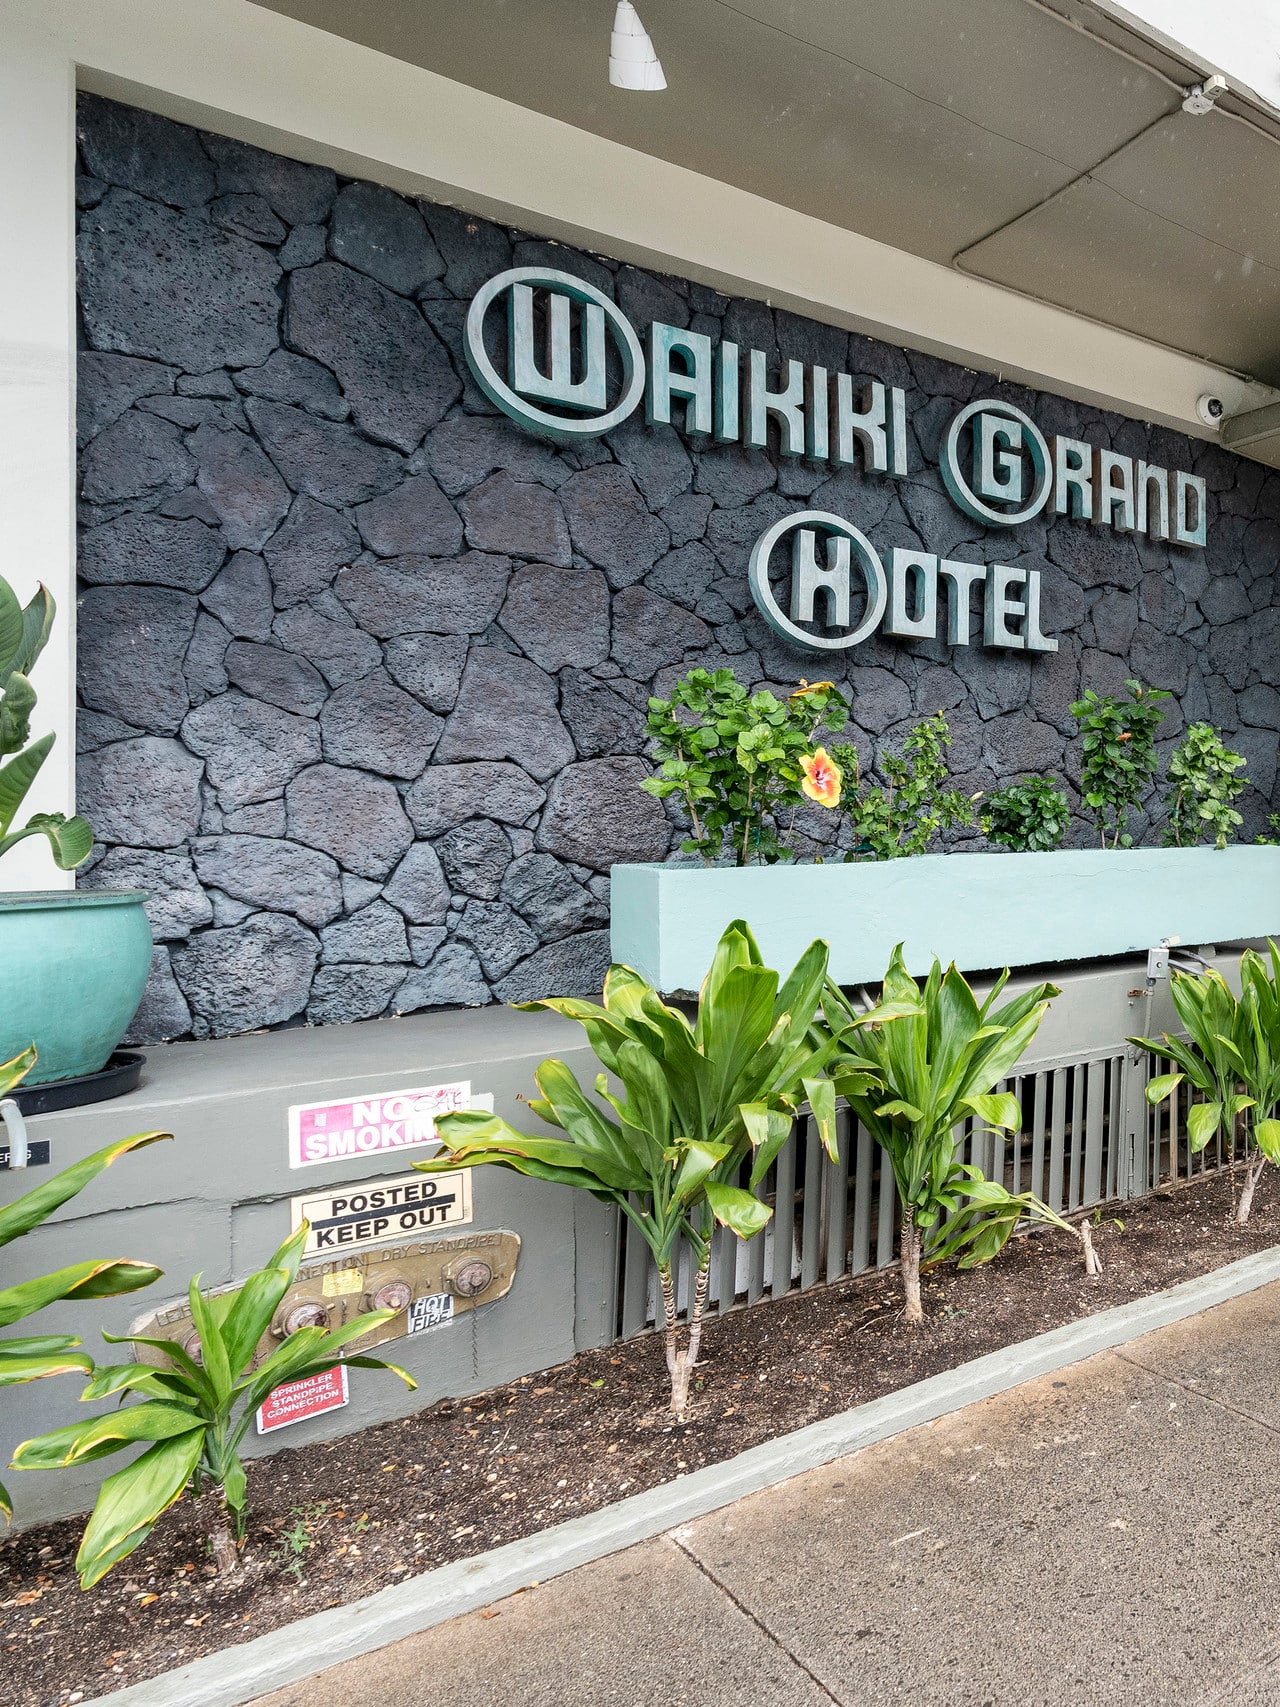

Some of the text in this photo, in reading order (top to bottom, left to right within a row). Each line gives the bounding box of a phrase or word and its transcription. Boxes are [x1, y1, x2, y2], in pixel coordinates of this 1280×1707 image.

[507, 283, 1207, 548] WAIKIKI GRAND
[790, 528, 1059, 653] HOTEL
[352, 1096, 411, 1127] NO
[305, 1117, 438, 1160] SMOKIN
[331, 1181, 437, 1217] POSTED
[316, 1204, 452, 1248] KEEP OUT
[381, 1244, 410, 1261] DRY
[418, 1233, 498, 1255] STANDPIPE
[270, 1373, 333, 1400] SPRINKLER
[271, 1382, 334, 1408] STANDPIPE
[266, 1389, 340, 1420] CONNECTION
